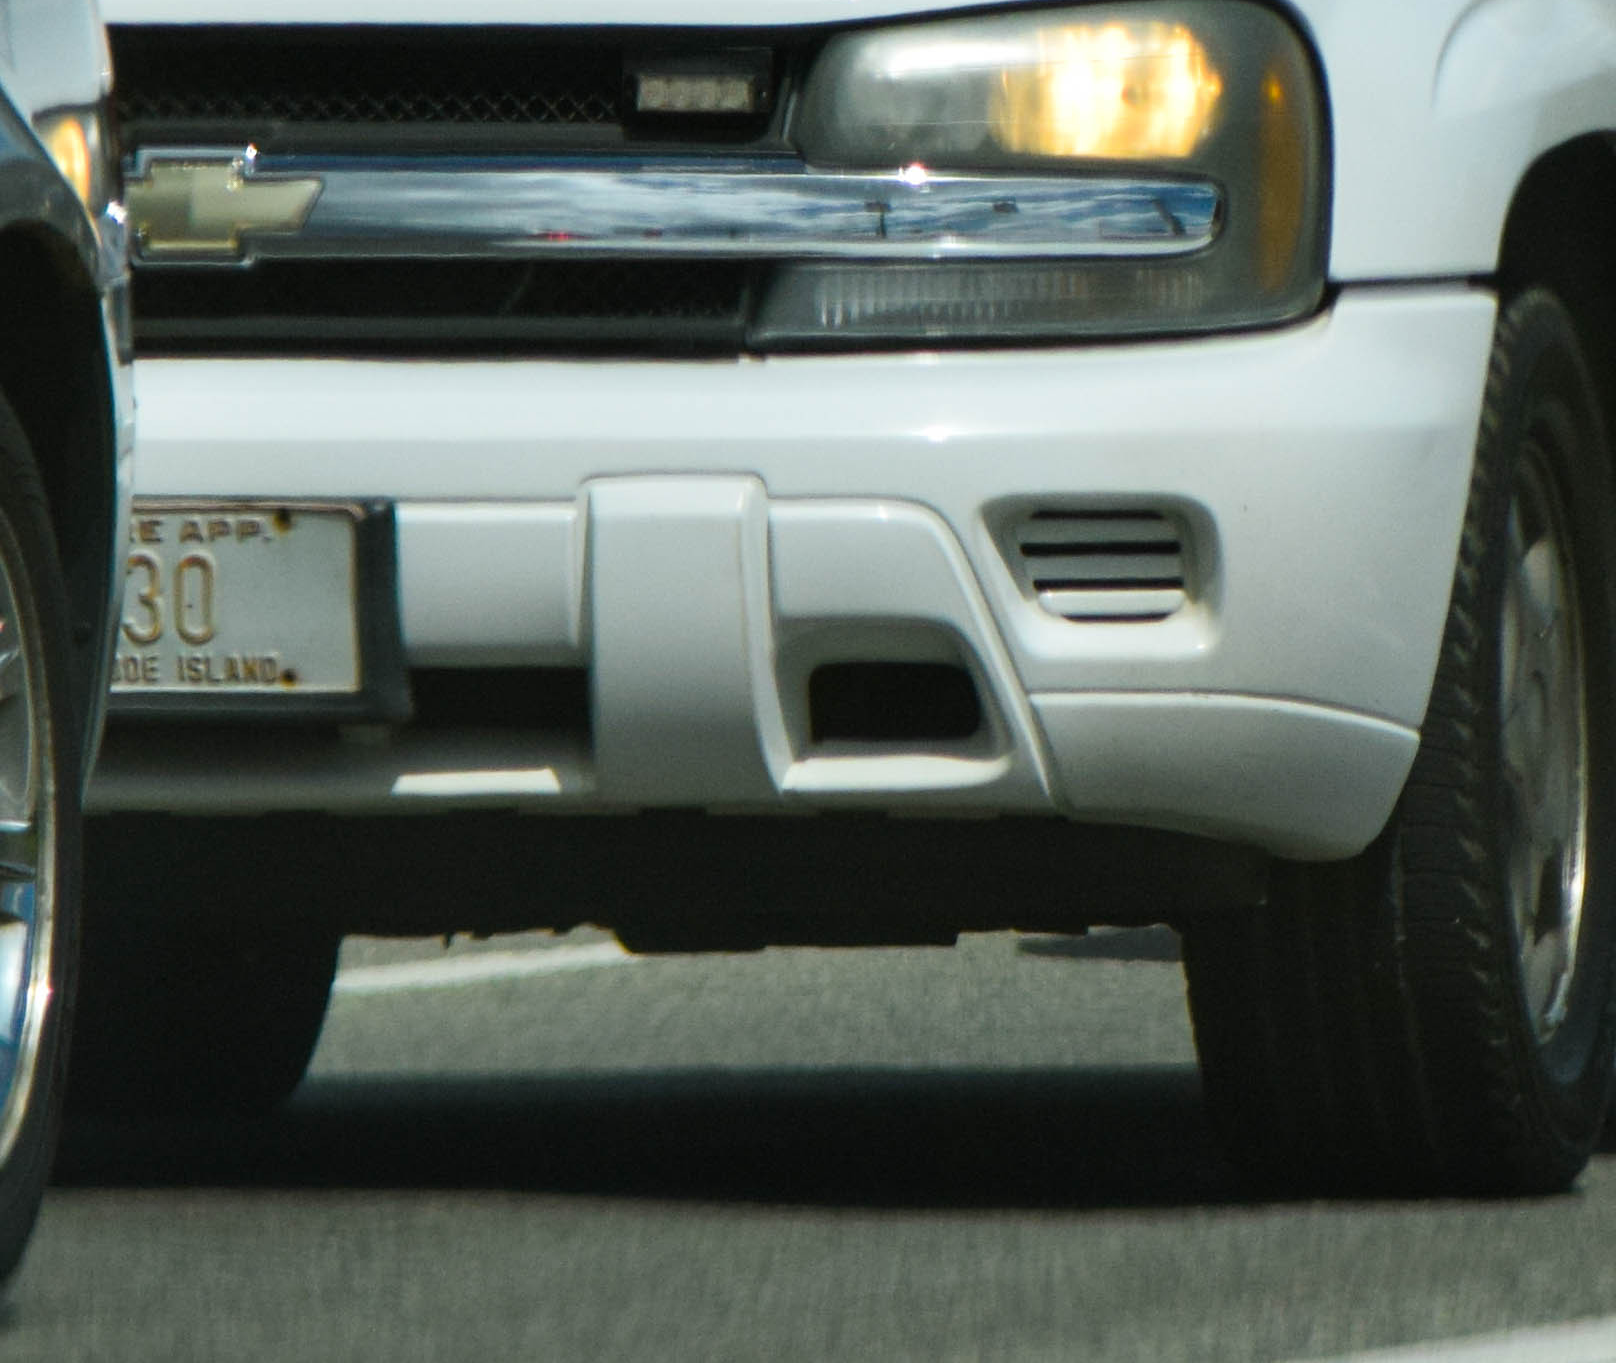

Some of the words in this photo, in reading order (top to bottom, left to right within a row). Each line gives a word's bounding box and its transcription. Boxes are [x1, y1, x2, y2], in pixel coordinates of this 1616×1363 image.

[129, 520, 163, 543] E
[179, 520, 272, 543] APP.
[122, 553, 216, 646] 30
[176, 655, 279, 684] ISLAND
